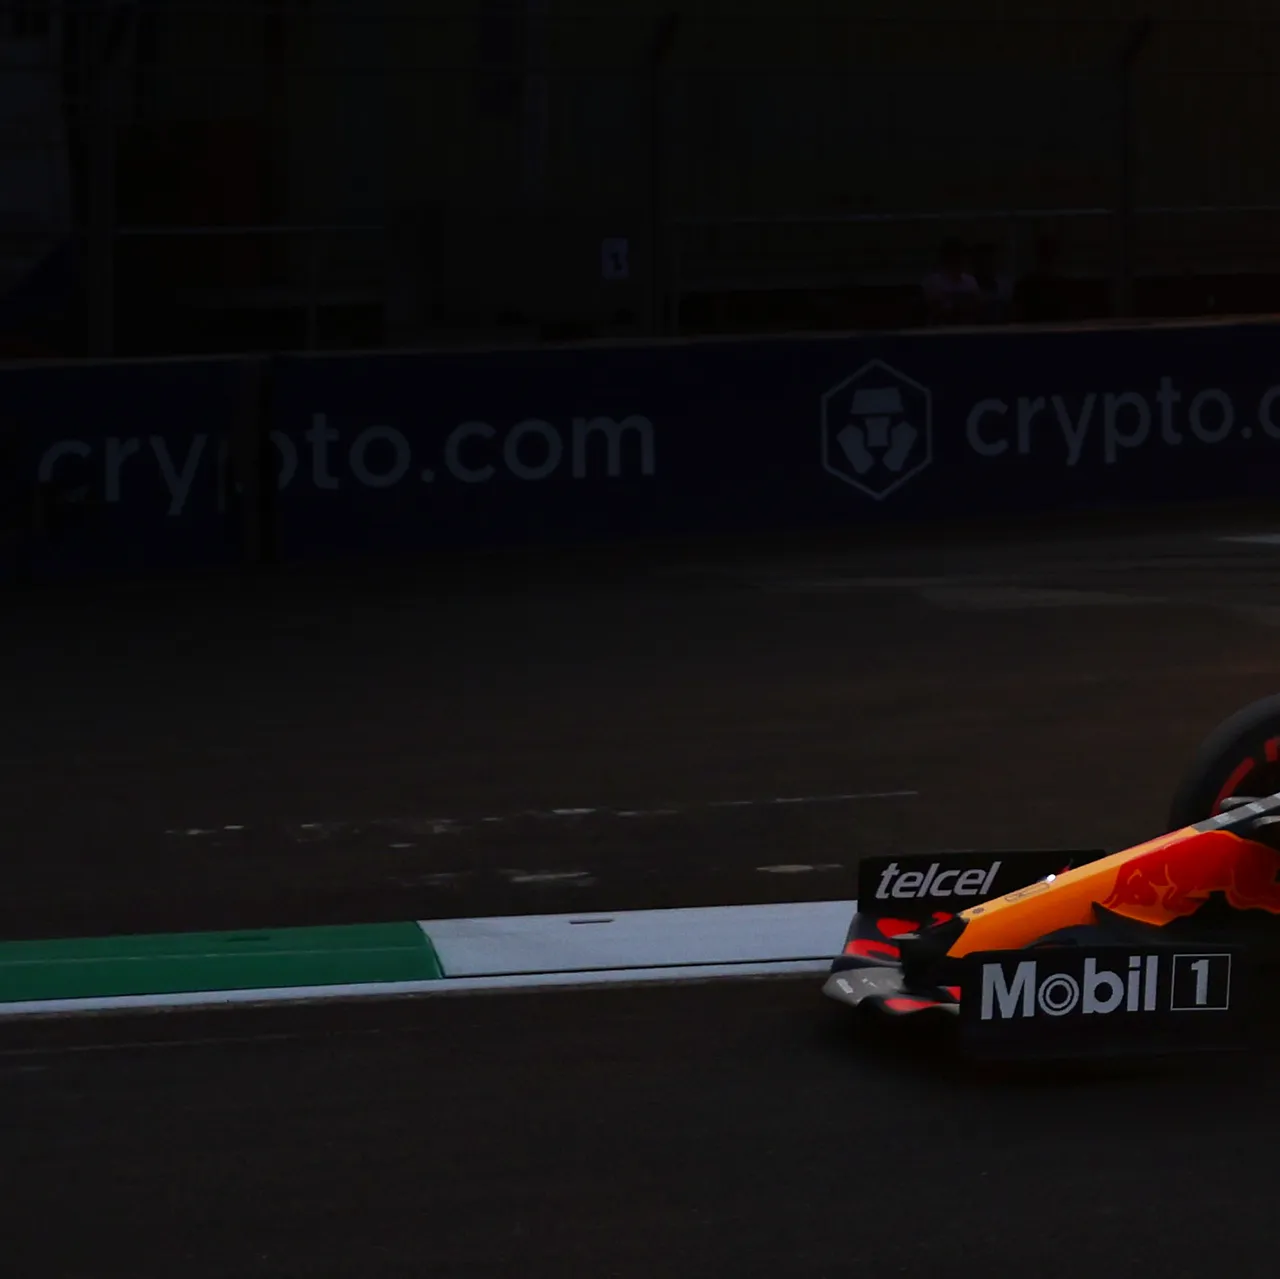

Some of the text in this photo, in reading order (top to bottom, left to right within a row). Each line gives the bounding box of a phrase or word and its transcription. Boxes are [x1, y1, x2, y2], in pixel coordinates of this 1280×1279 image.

[875, 860, 1003, 900] telcel
[980, 955, 1211, 1021] Mobil 1
